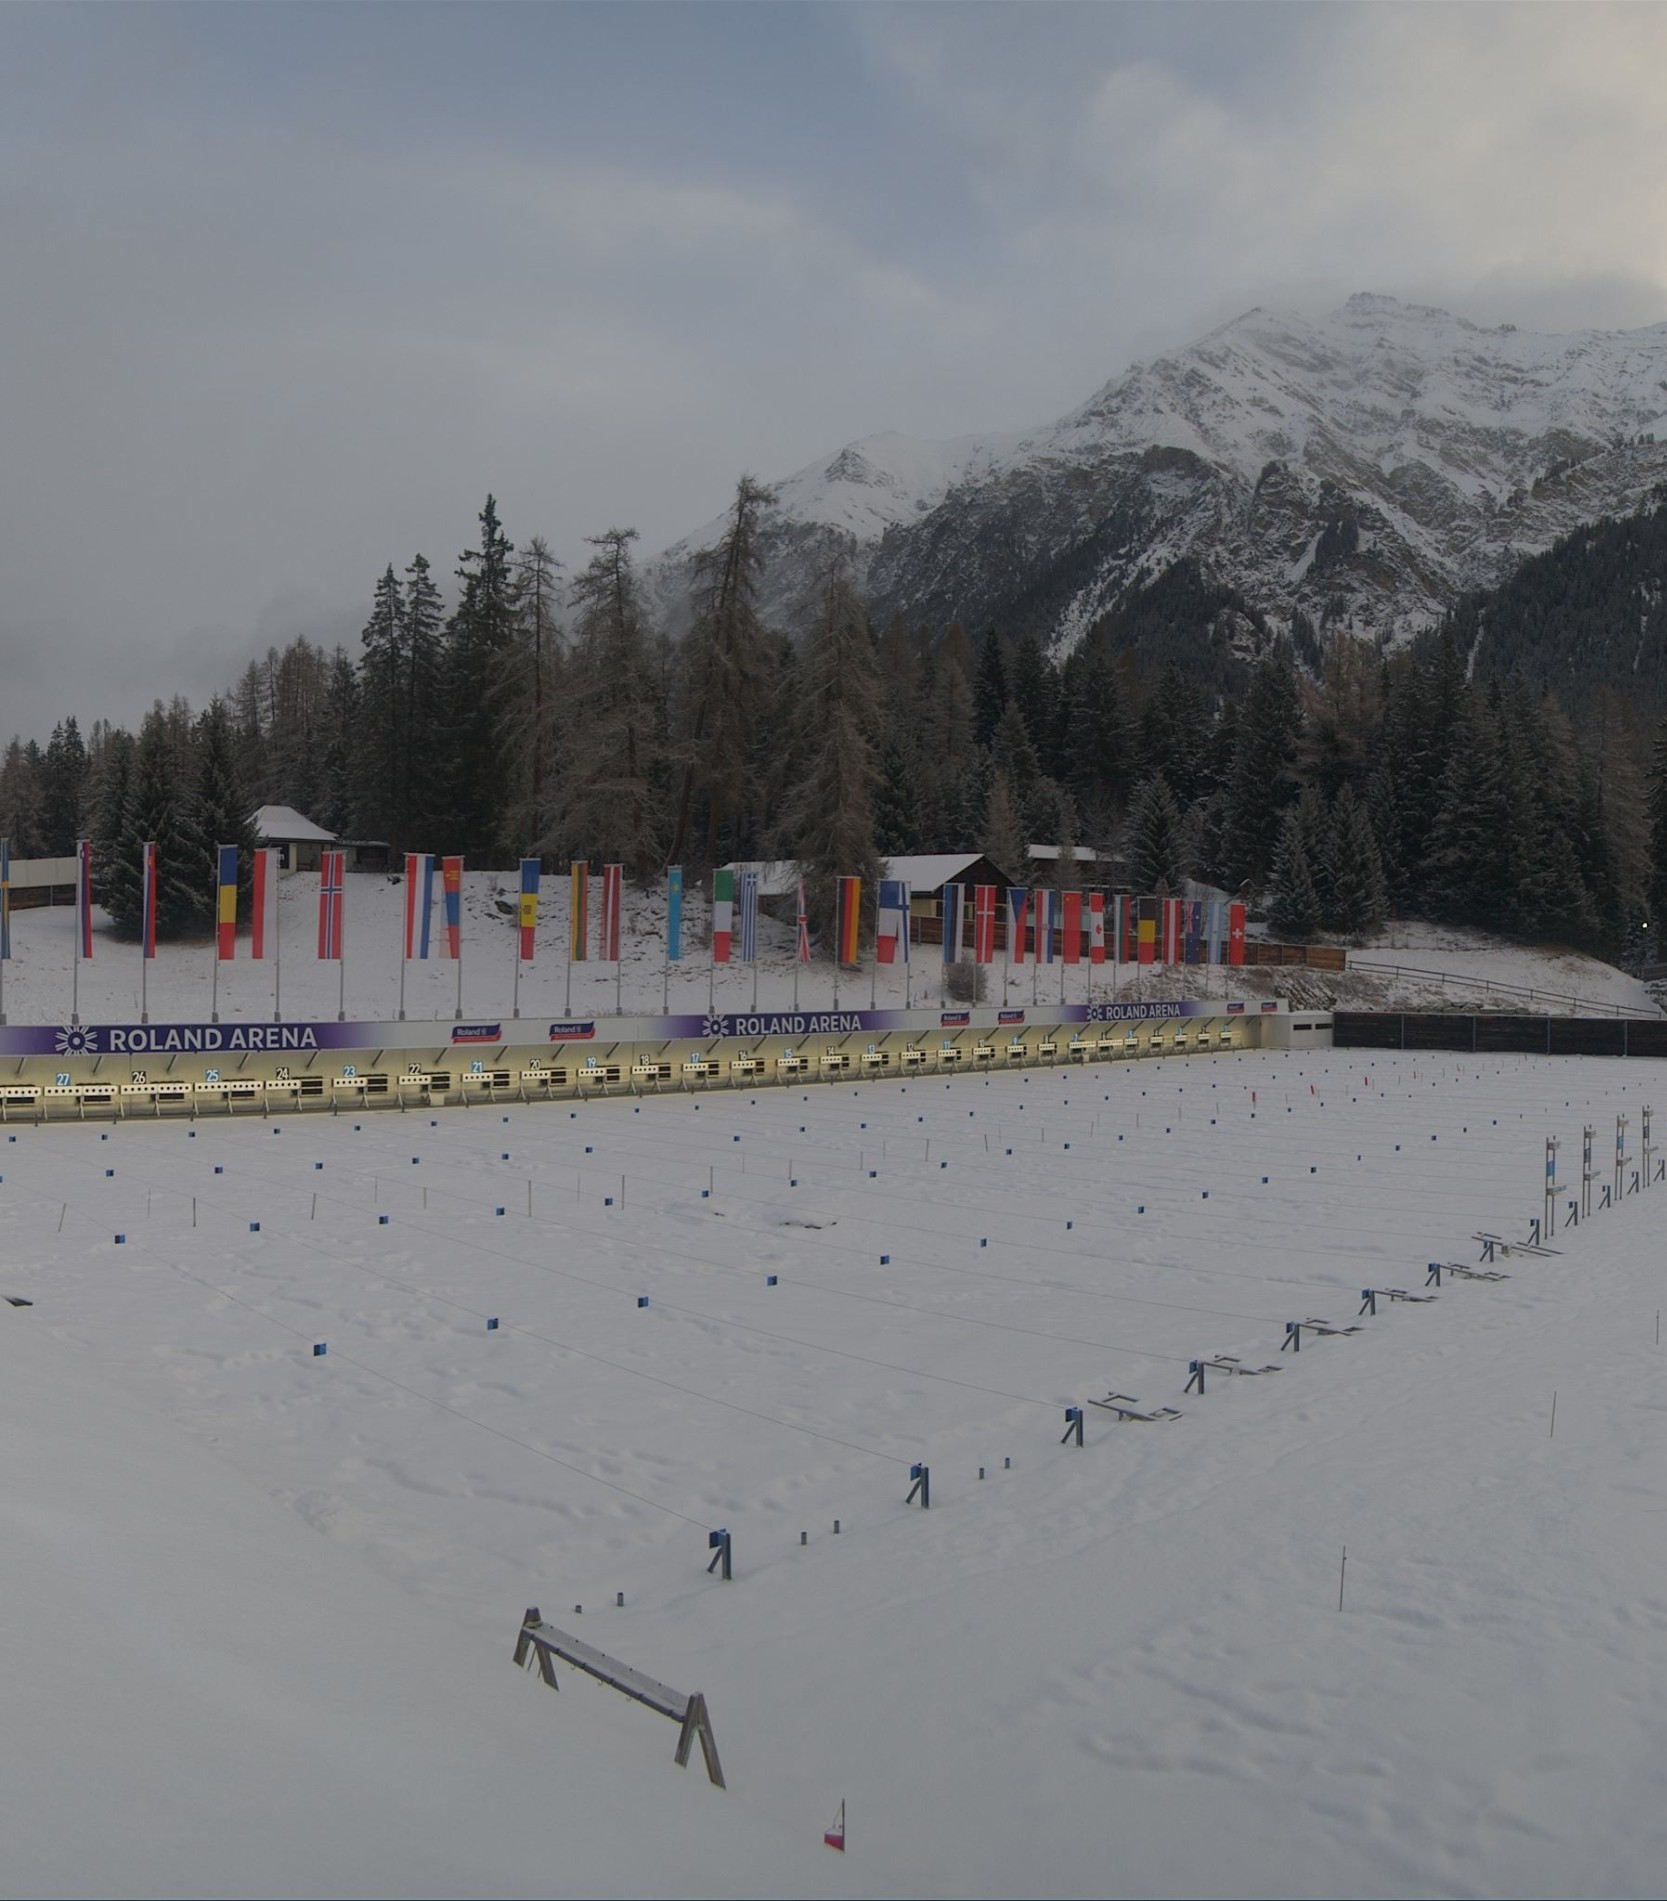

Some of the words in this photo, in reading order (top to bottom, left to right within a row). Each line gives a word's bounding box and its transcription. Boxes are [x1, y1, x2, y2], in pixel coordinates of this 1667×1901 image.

[1105, 1005, 1147, 1020] ROLAND
[1149, 1004, 1181, 1018] ARENA
[735, 1017, 805, 1035] ROLAND
[808, 1015, 862, 1033] ARENA
[457, 1027, 480, 1036] Roland
[109, 1028, 223, 1051] ROLAND
[230, 1027, 318, 1049] ARENA
[785, 1049, 793, 1057] 15
[827, 1047, 835, 1055] 14
[868, 1045, 875, 1053] 13
[640, 1055, 650, 1065] 18
[691, 1053, 700, 1062] 17
[739, 1051, 748, 1060] 16
[472, 1062, 483, 1072] 21
[530, 1060, 541, 1070] 20
[587, 1057, 597, 1067] 19
[276, 1068, 289, 1080] 24
[344, 1066, 356, 1077] 23
[409, 1064, 421, 1074] 22
[56, 1074, 69, 1087] 27
[133, 1072, 146, 1084] 26
[206, 1070, 219, 1082] 25
